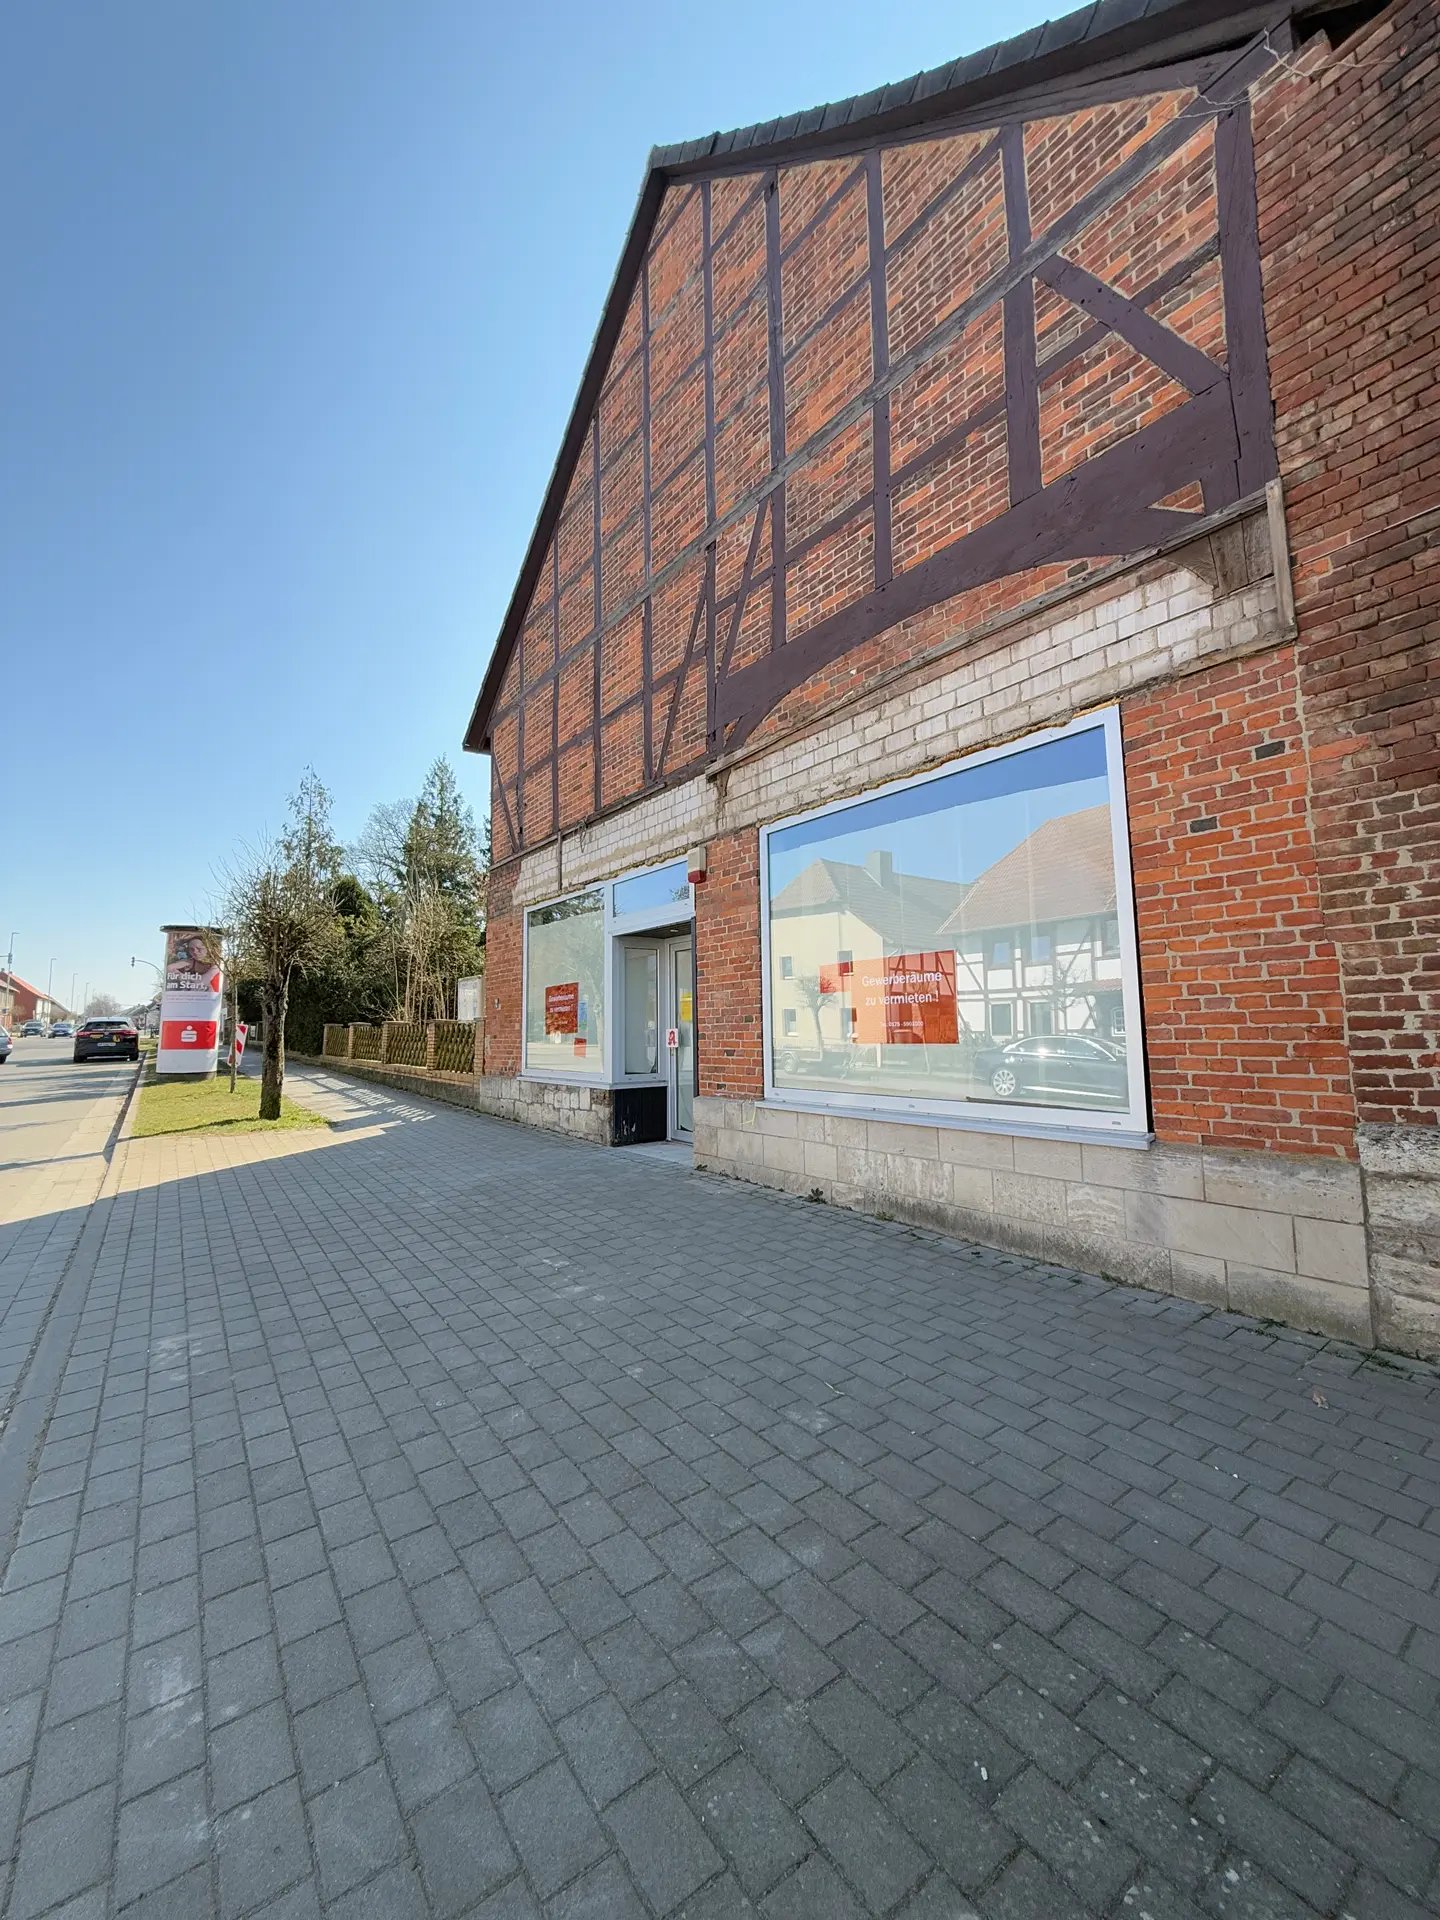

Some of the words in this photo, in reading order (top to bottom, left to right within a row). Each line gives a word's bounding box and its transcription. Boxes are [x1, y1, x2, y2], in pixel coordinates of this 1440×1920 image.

[167, 972, 179, 980] Für
[181, 972, 202, 980] dich
[861, 971, 942, 987] Gewerberäume
[865, 997, 877, 1006] zu
[879, 992, 932, 1005] vermieten
